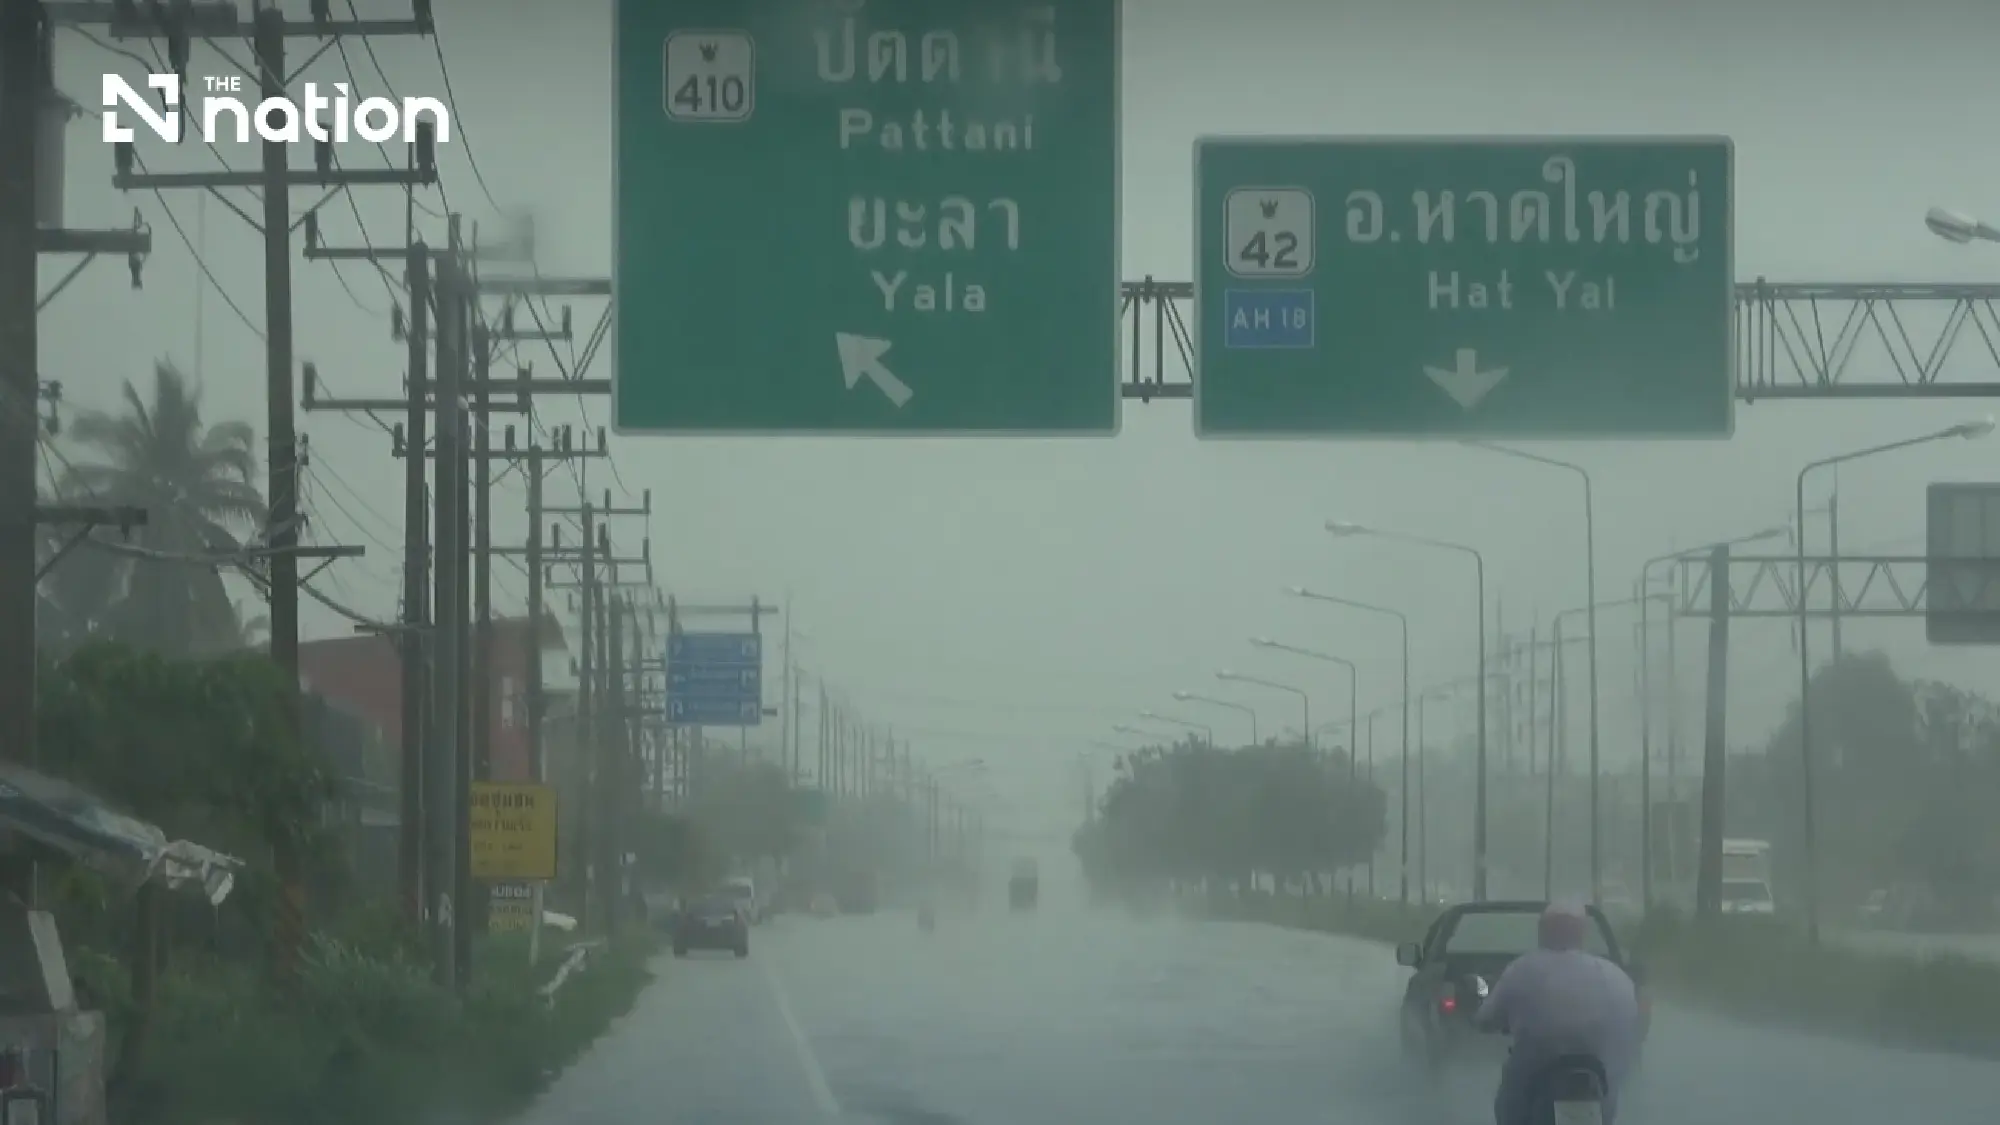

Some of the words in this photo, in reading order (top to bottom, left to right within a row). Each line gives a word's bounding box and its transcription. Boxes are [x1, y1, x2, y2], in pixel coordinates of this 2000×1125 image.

[674, 74, 745, 113] 410
[839, 108, 1034, 151] Pattani
[848, 194, 1021, 251] ยะลา
[1345, 154, 1702, 264] อ.หาดใหญ่
[1240, 229, 1299, 269] 42
[871, 269, 988, 313] Yala
[1427, 268, 1513, 310] Hat
[1545, 270, 1615, 310] Yai
[1231, 306, 1271, 330] AH
[1281, 306, 1307, 330] 18
